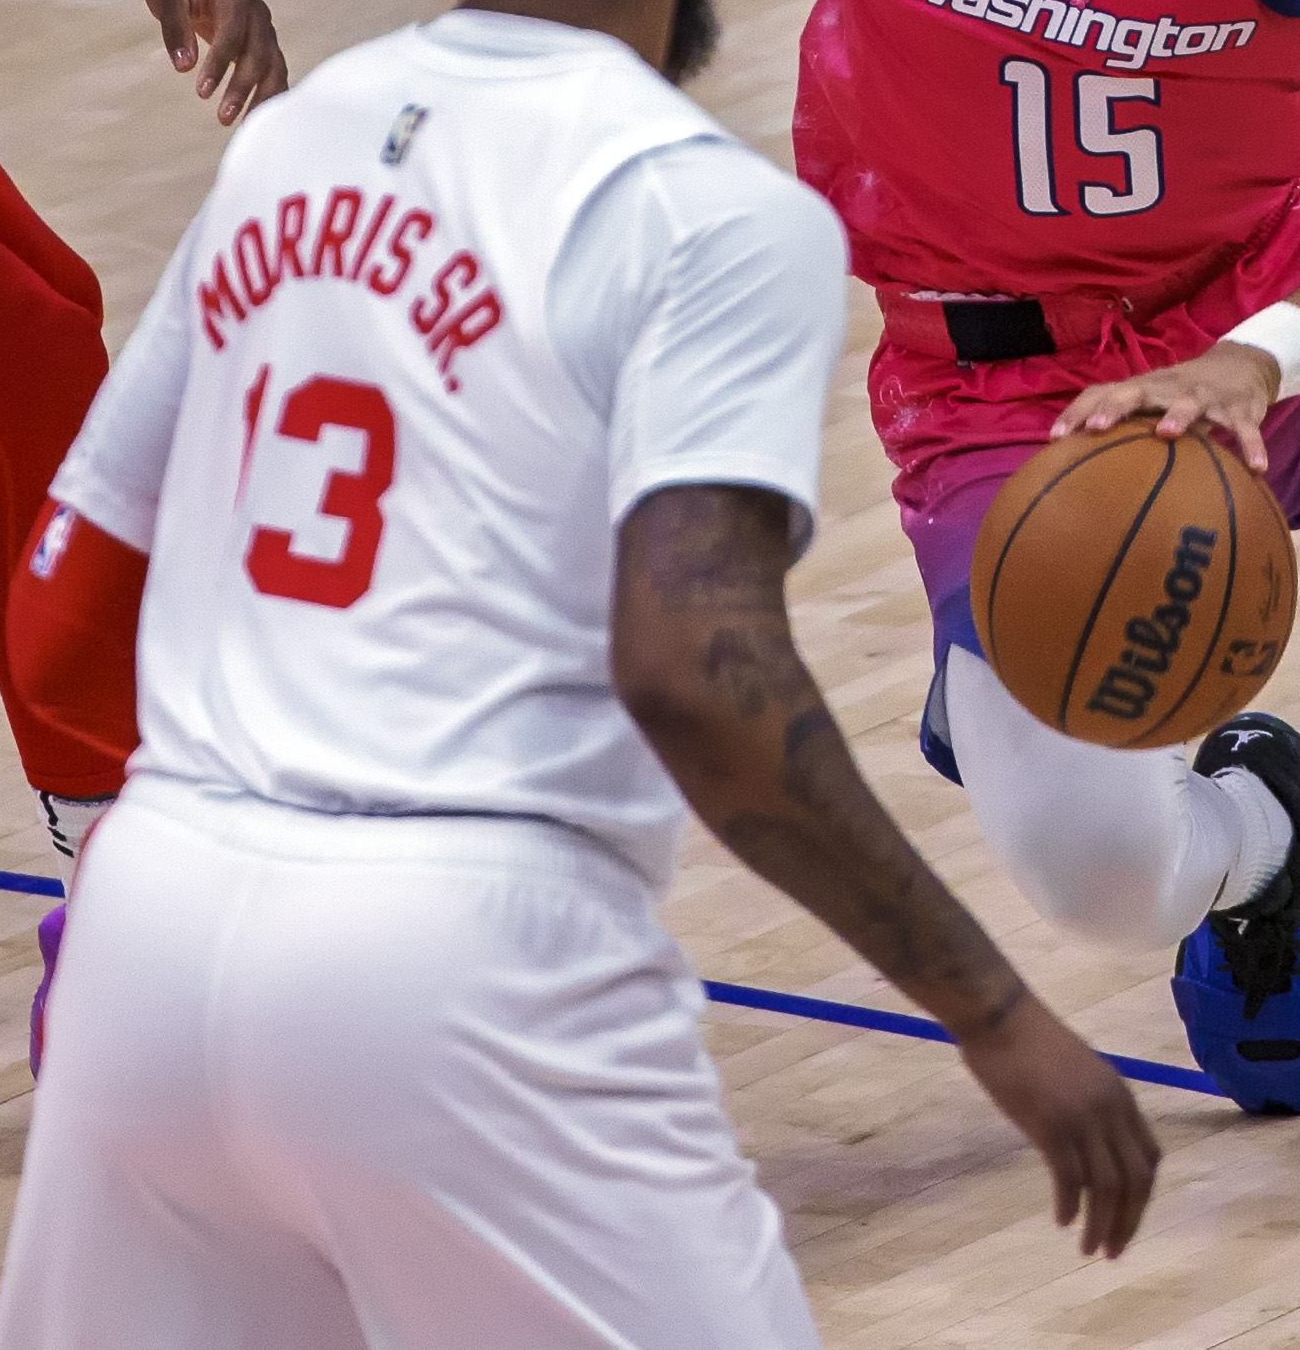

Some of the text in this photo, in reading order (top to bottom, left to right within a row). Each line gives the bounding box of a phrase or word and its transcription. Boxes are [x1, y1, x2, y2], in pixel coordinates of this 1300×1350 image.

[1000, 56, 1164, 217] 15
[198, 186, 505, 394] MORRIS SR.
[1085, 525, 1219, 720] Wilson
